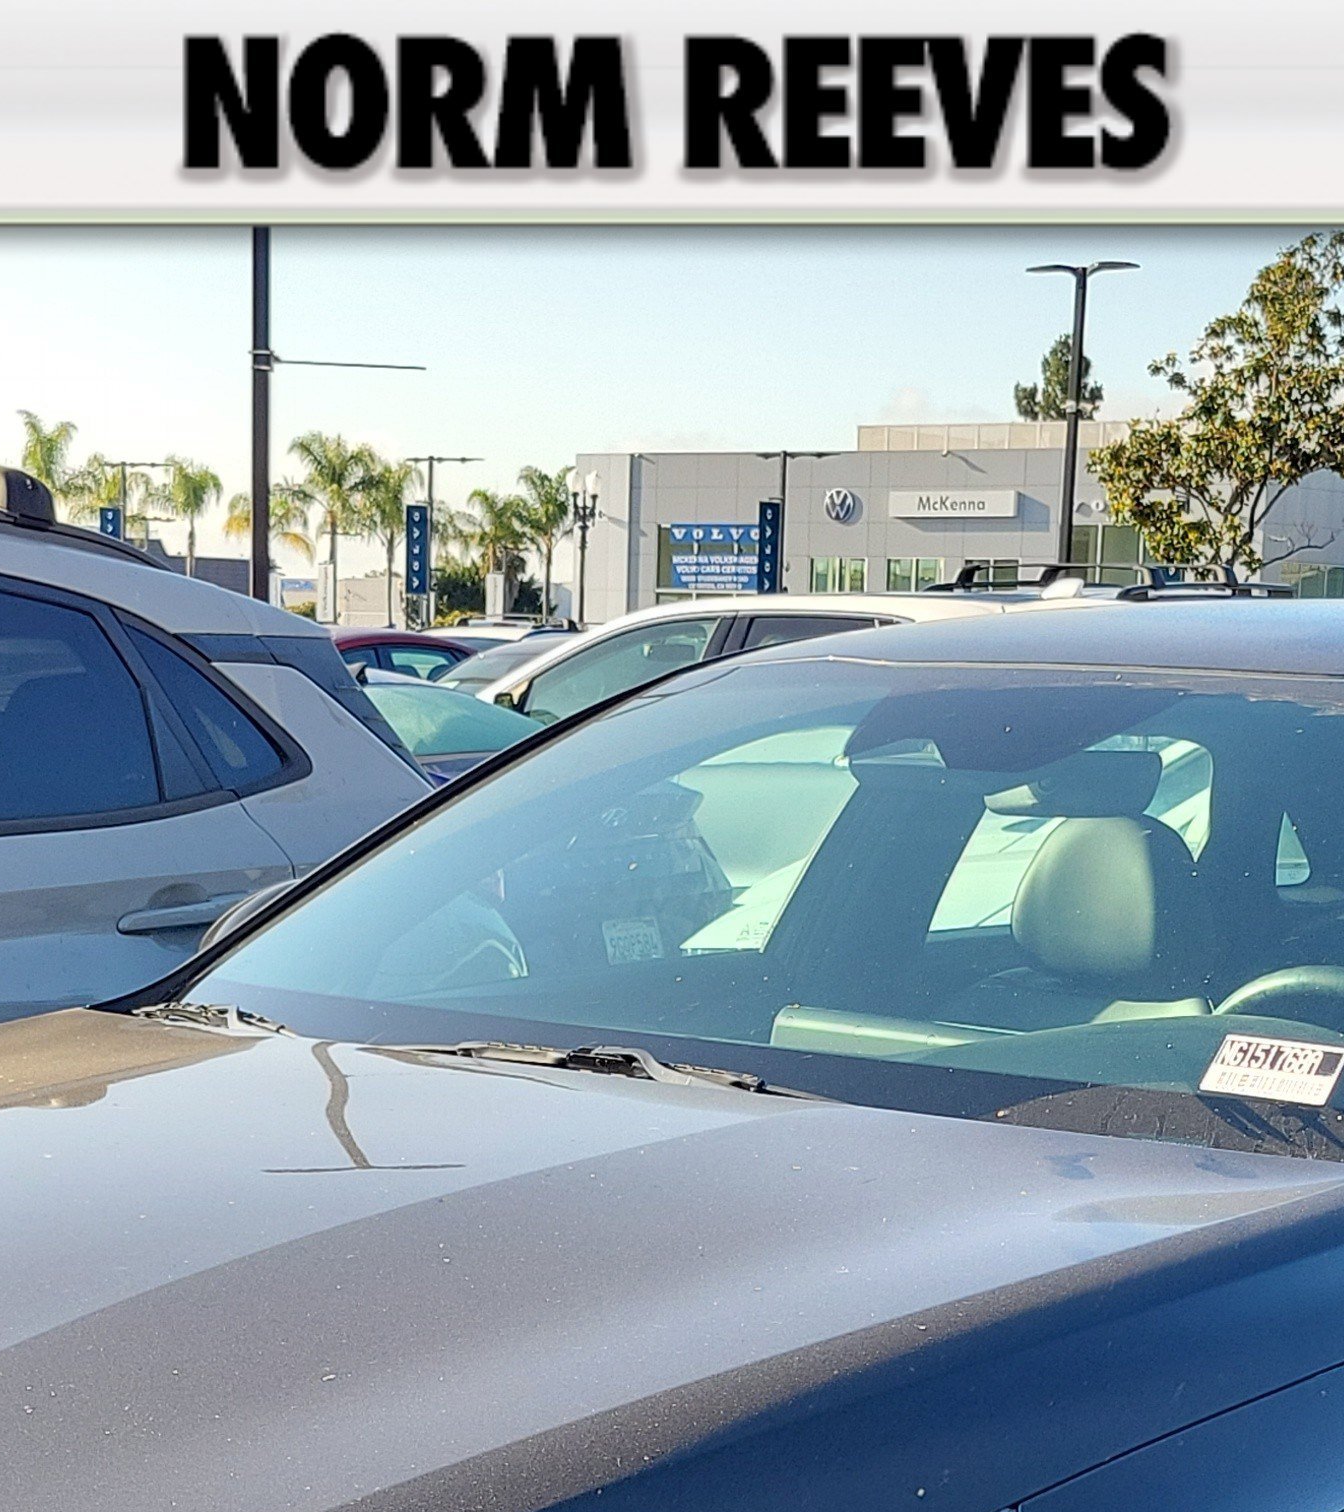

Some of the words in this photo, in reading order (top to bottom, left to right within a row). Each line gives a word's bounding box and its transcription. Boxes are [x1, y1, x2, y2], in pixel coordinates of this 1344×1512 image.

[916, 495, 986, 512] McKenna
[412, 511, 421, 589] VOLVO
[671, 527, 760, 540] VOLVO
[763, 508, 773, 591] VOLVO
